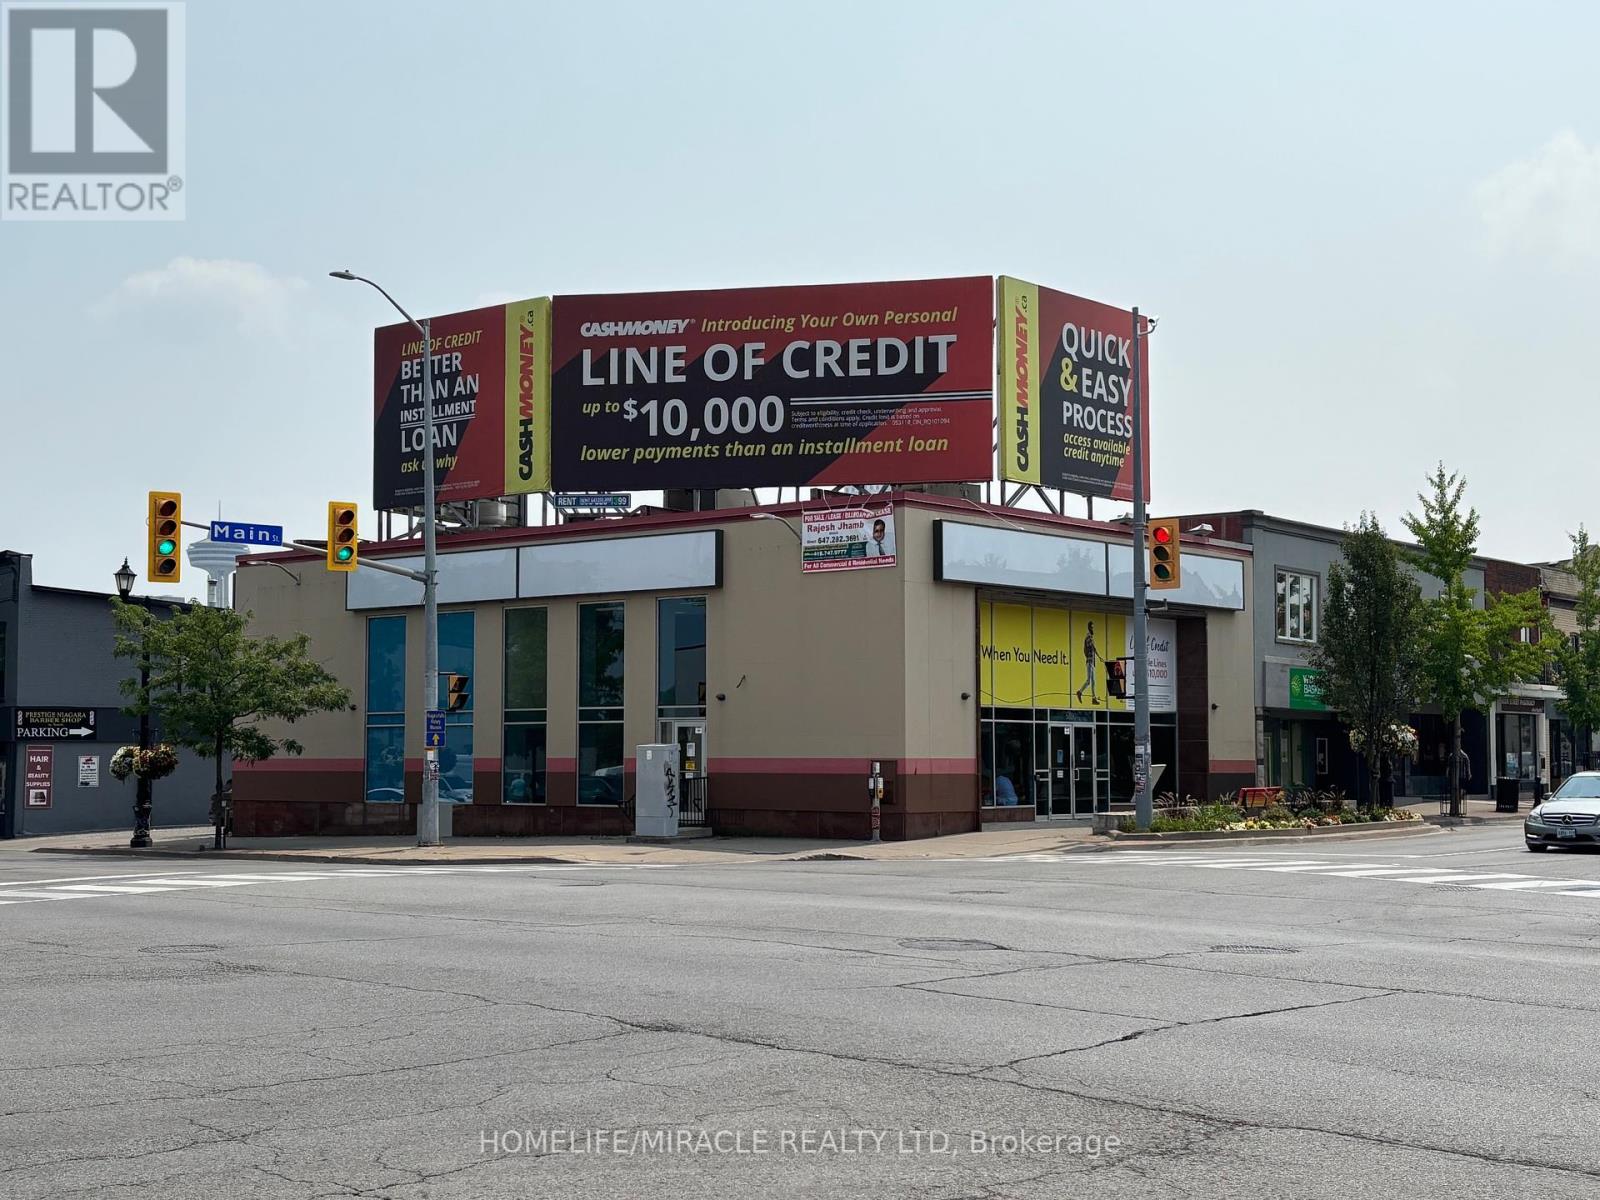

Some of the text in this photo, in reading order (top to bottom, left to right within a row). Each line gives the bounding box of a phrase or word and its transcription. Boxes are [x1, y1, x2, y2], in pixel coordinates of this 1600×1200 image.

[701, 315, 796, 333] Introducing
[800, 313, 838, 329] Your
[842, 312, 879, 327] Own
[884, 306, 958, 325] Personal
[444, 330, 483, 349] CREDIT
[1062, 322, 1131, 369] QUICK
[401, 352, 463, 380] BETER
[582, 334, 958, 386] LINE OF CREDIT
[452, 373, 480, 397] AN
[1060, 357, 1132, 407] & EASY
[400, 400, 477, 423] INSTLLMENT
[582, 395, 785, 442] up to $10,000
[791, 410, 810, 418] Subject
[1062, 400, 1133, 439] PROCESS
[580, 436, 949, 464] lower payments than an installment loan
[1063, 432, 1131, 455] access available
[401, 458, 419, 473] ask
[436, 453, 458, 471] why
[1063, 446, 1125, 467] credit anytime
[558, 497, 577, 506] RENT
[828, 512, 842, 520] LEASE
[214, 524, 270, 542] Main
[807, 519, 865, 535] Rajesh Jhamb
[981, 644, 1011, 661] When
[1012, 646, 1030, 663] You
[1034, 648, 1058, 665] Need
[1150, 637, 1170, 652] Credit
[1153, 658, 1167, 668] Lines
[17, 727, 69, 737] PARKING
[29, 755, 49, 763] HAIR
